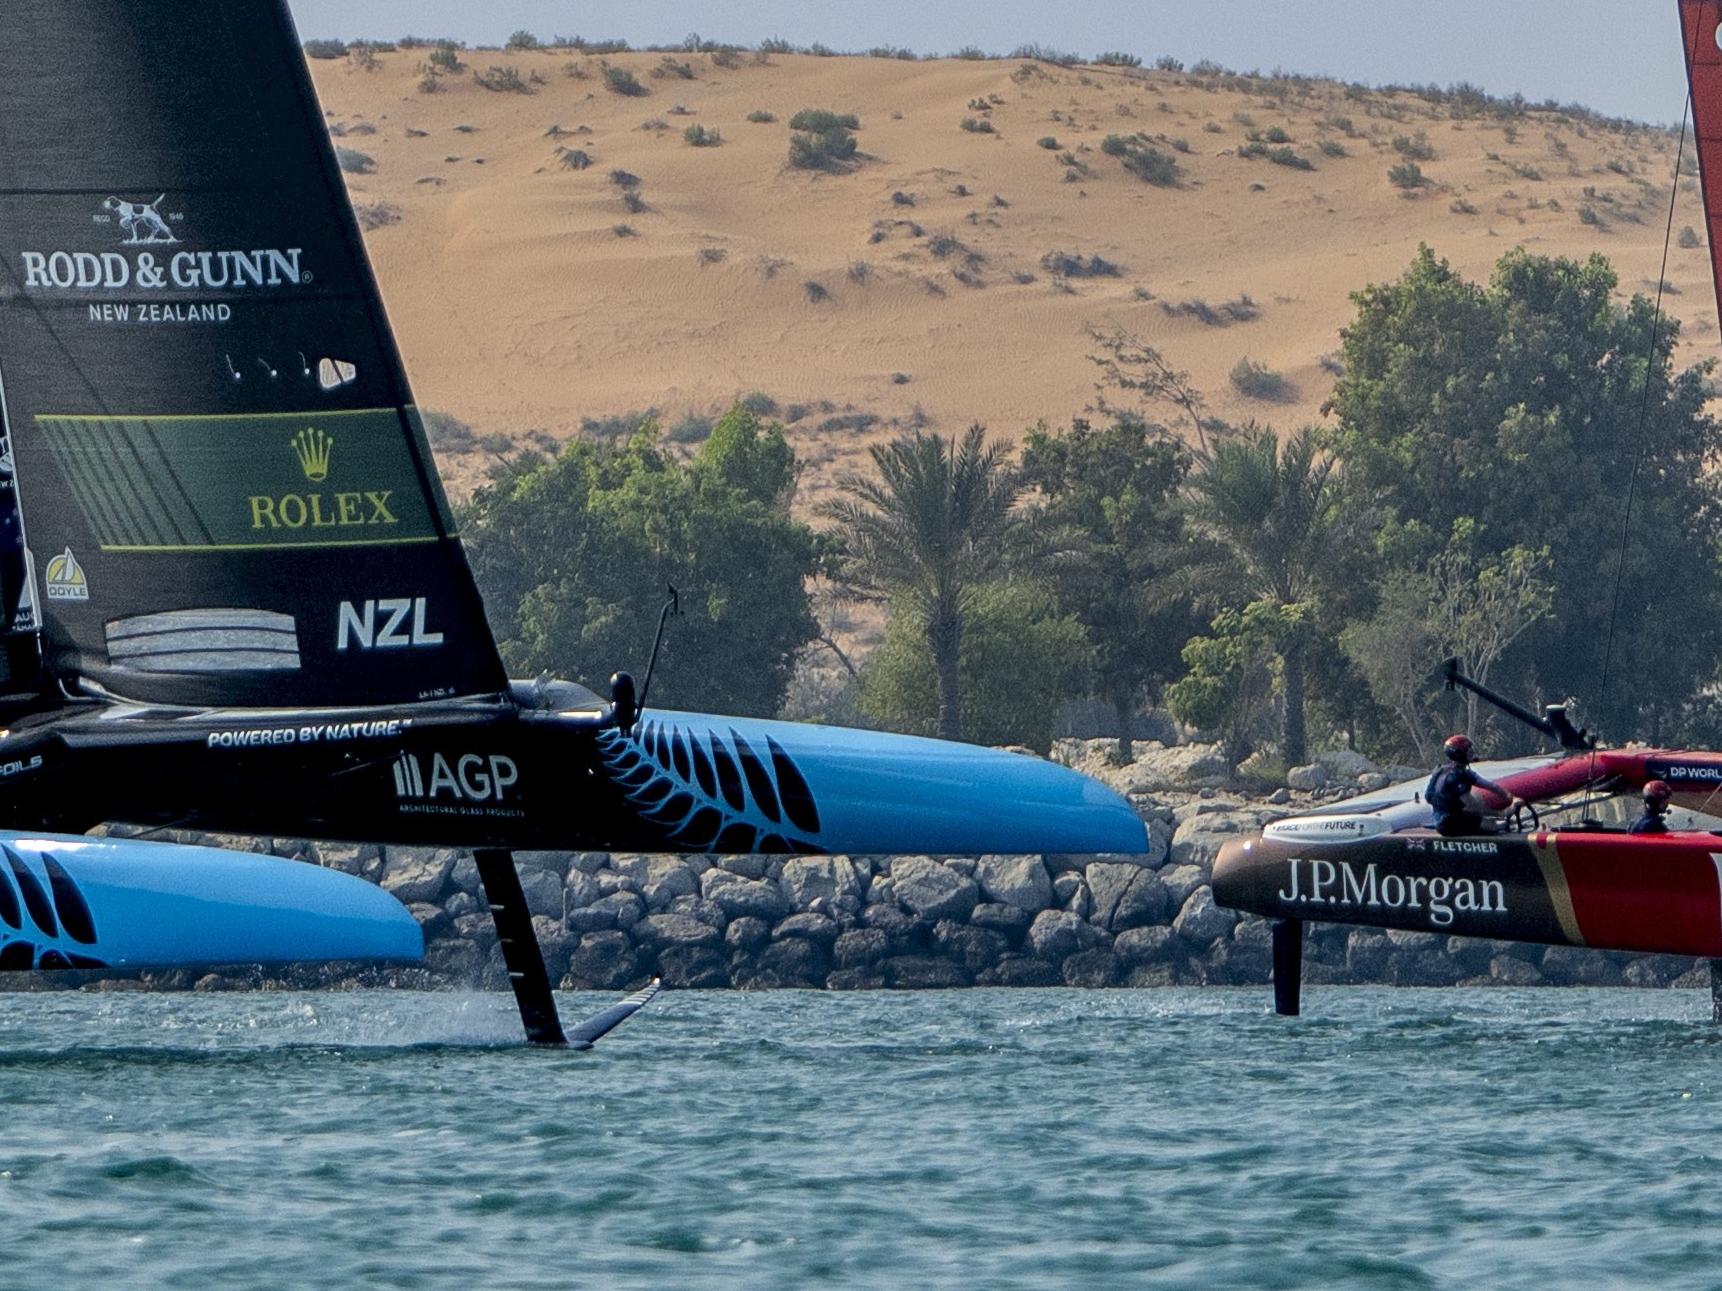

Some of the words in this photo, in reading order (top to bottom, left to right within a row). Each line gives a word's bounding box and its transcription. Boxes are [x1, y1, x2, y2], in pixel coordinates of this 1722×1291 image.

[22, 251, 130, 287] RODD
[137, 252, 166, 287] &
[90, 304, 131, 321] NEW
[138, 304, 231, 321] ZEALAND
[249, 490, 399, 529] ROLEX
[48, 586, 86, 597] DOYLE
[338, 597, 444, 649] NZL
[208, 728, 295, 747] POWERED
[299, 725, 325, 742] BY
[429, 752, 518, 800] AGP
[1670, 766, 1689, 779] DP
[399, 804, 458, 814] ARCHITECTURAL
[1434, 841, 1498, 853] FLETCHER
